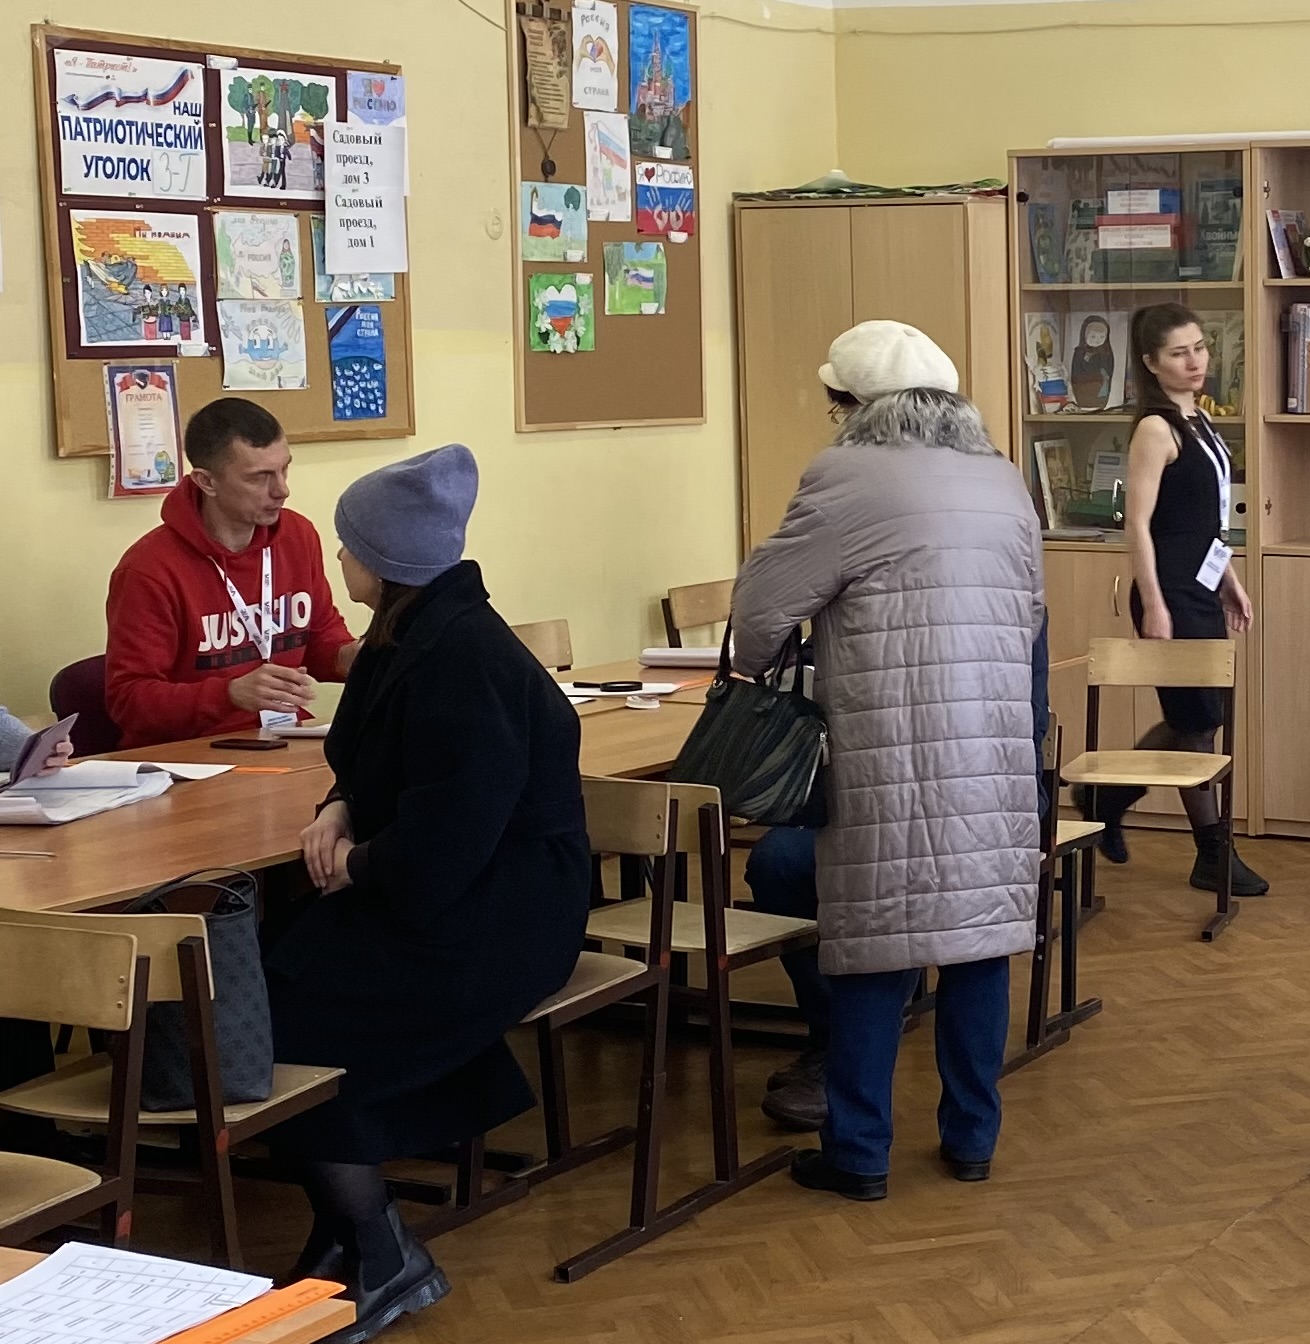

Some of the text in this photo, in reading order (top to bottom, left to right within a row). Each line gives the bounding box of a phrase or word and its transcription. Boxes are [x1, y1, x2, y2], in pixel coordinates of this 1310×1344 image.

[172, 100, 202, 118] НАШ
[60, 115, 204, 150] ПАТРИОТИЧЕСКИЙ
[332, 128, 383, 146] Садовый
[82, 154, 152, 182] УГОЛОК
[335, 153, 374, 168] проезд,
[342, 172, 370, 186] дом 3
[334, 193, 384, 210] Садовый
[338, 216, 377, 232] проезд,
[347, 236, 375, 249] дом 1
[1200, 228, 1239, 241] Хвойны
[125, 392, 163, 403] ГРАМОТА
